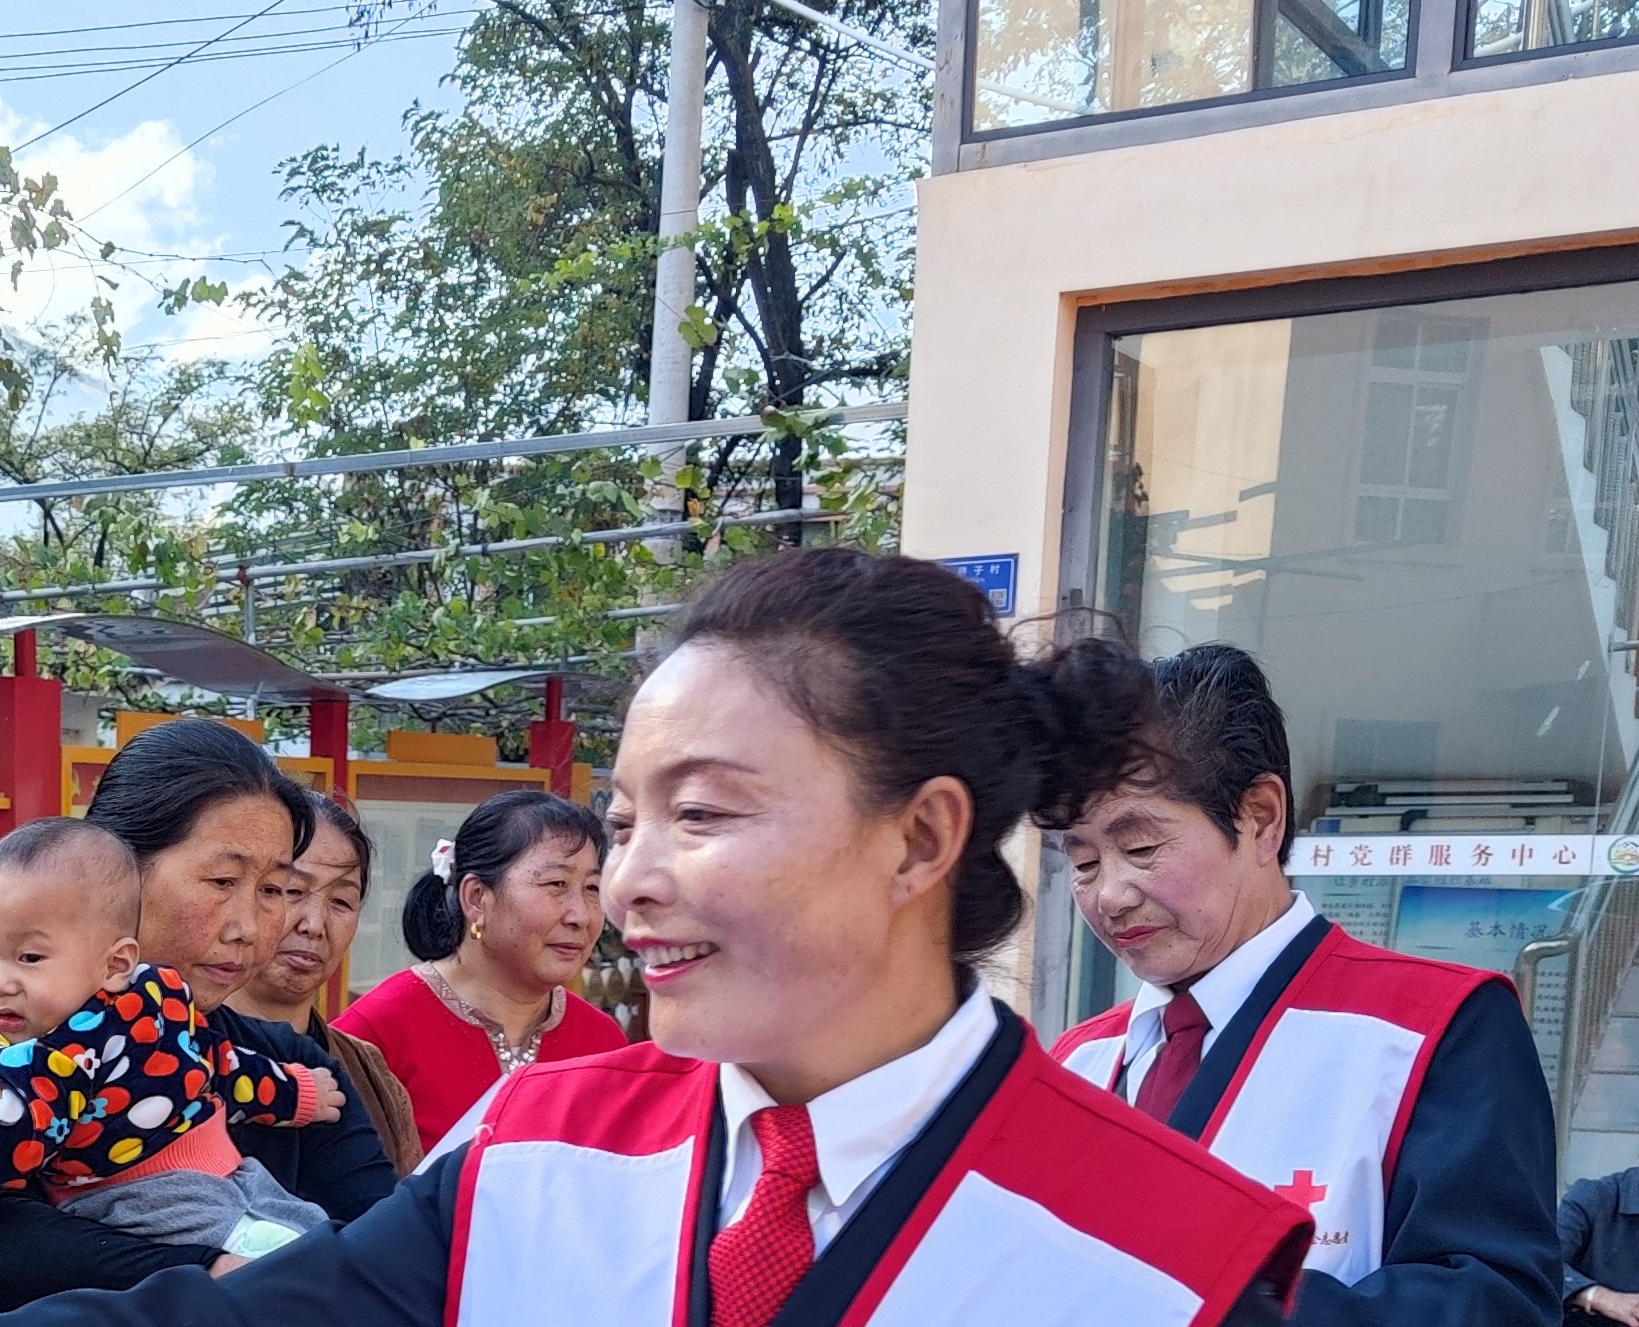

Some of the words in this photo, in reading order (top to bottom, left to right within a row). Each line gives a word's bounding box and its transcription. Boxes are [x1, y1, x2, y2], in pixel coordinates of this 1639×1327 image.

[1310, 844, 1577, 867] 村党群服务中心
